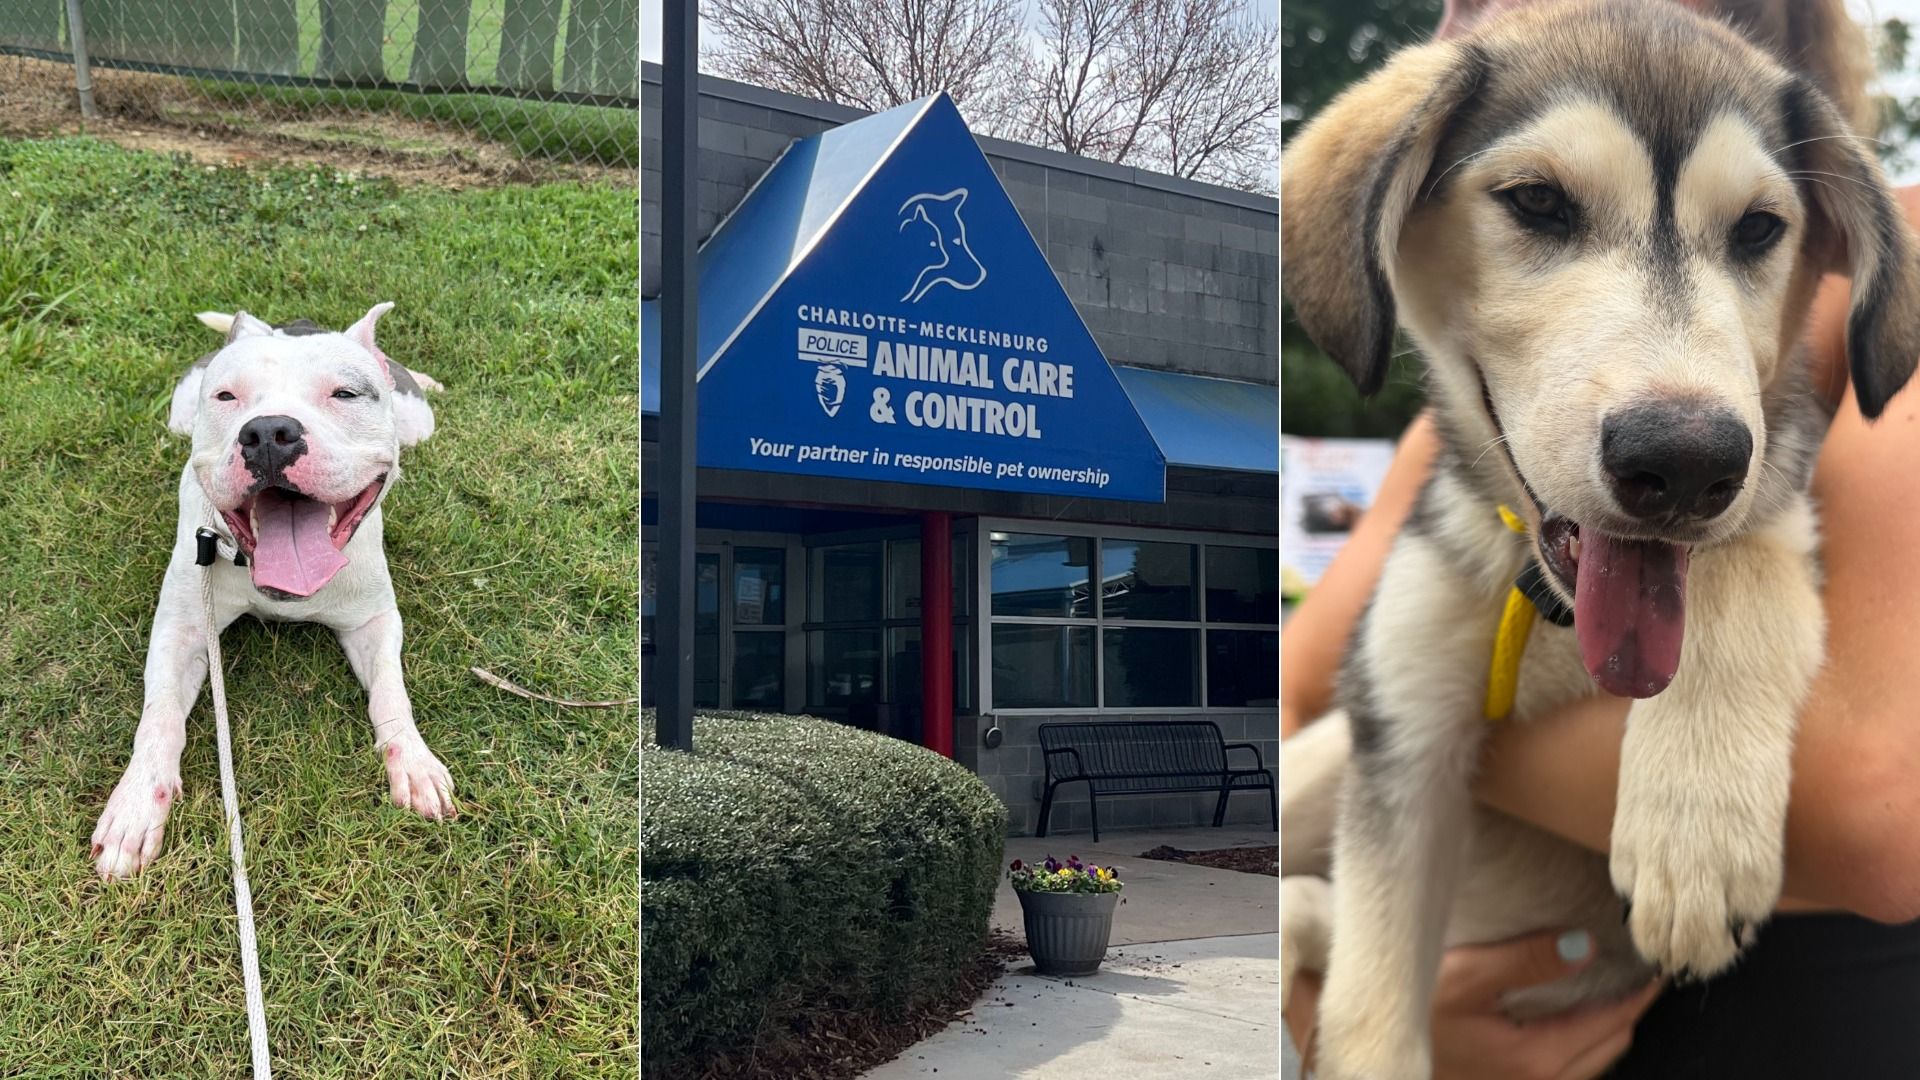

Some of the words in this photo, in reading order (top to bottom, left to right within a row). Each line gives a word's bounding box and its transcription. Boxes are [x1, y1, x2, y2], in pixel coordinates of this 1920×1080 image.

[798, 304, 1048, 353] CHARLOTTE-MECKLENBURG
[806, 335, 859, 355] POLICE
[872, 340, 994, 389] ANIMAL
[1002, 357, 1074, 399] CARE
[869, 386, 897, 425] &
[905, 390, 1041, 439] CONTROL
[750, 438, 795, 459] Your
[797, 443, 869, 465] partner
[872, 452, 890, 465] in
[894, 453, 993, 474] responsible
[996, 461, 1025, 479] pet
[1027, 466, 1110, 488] ownership
